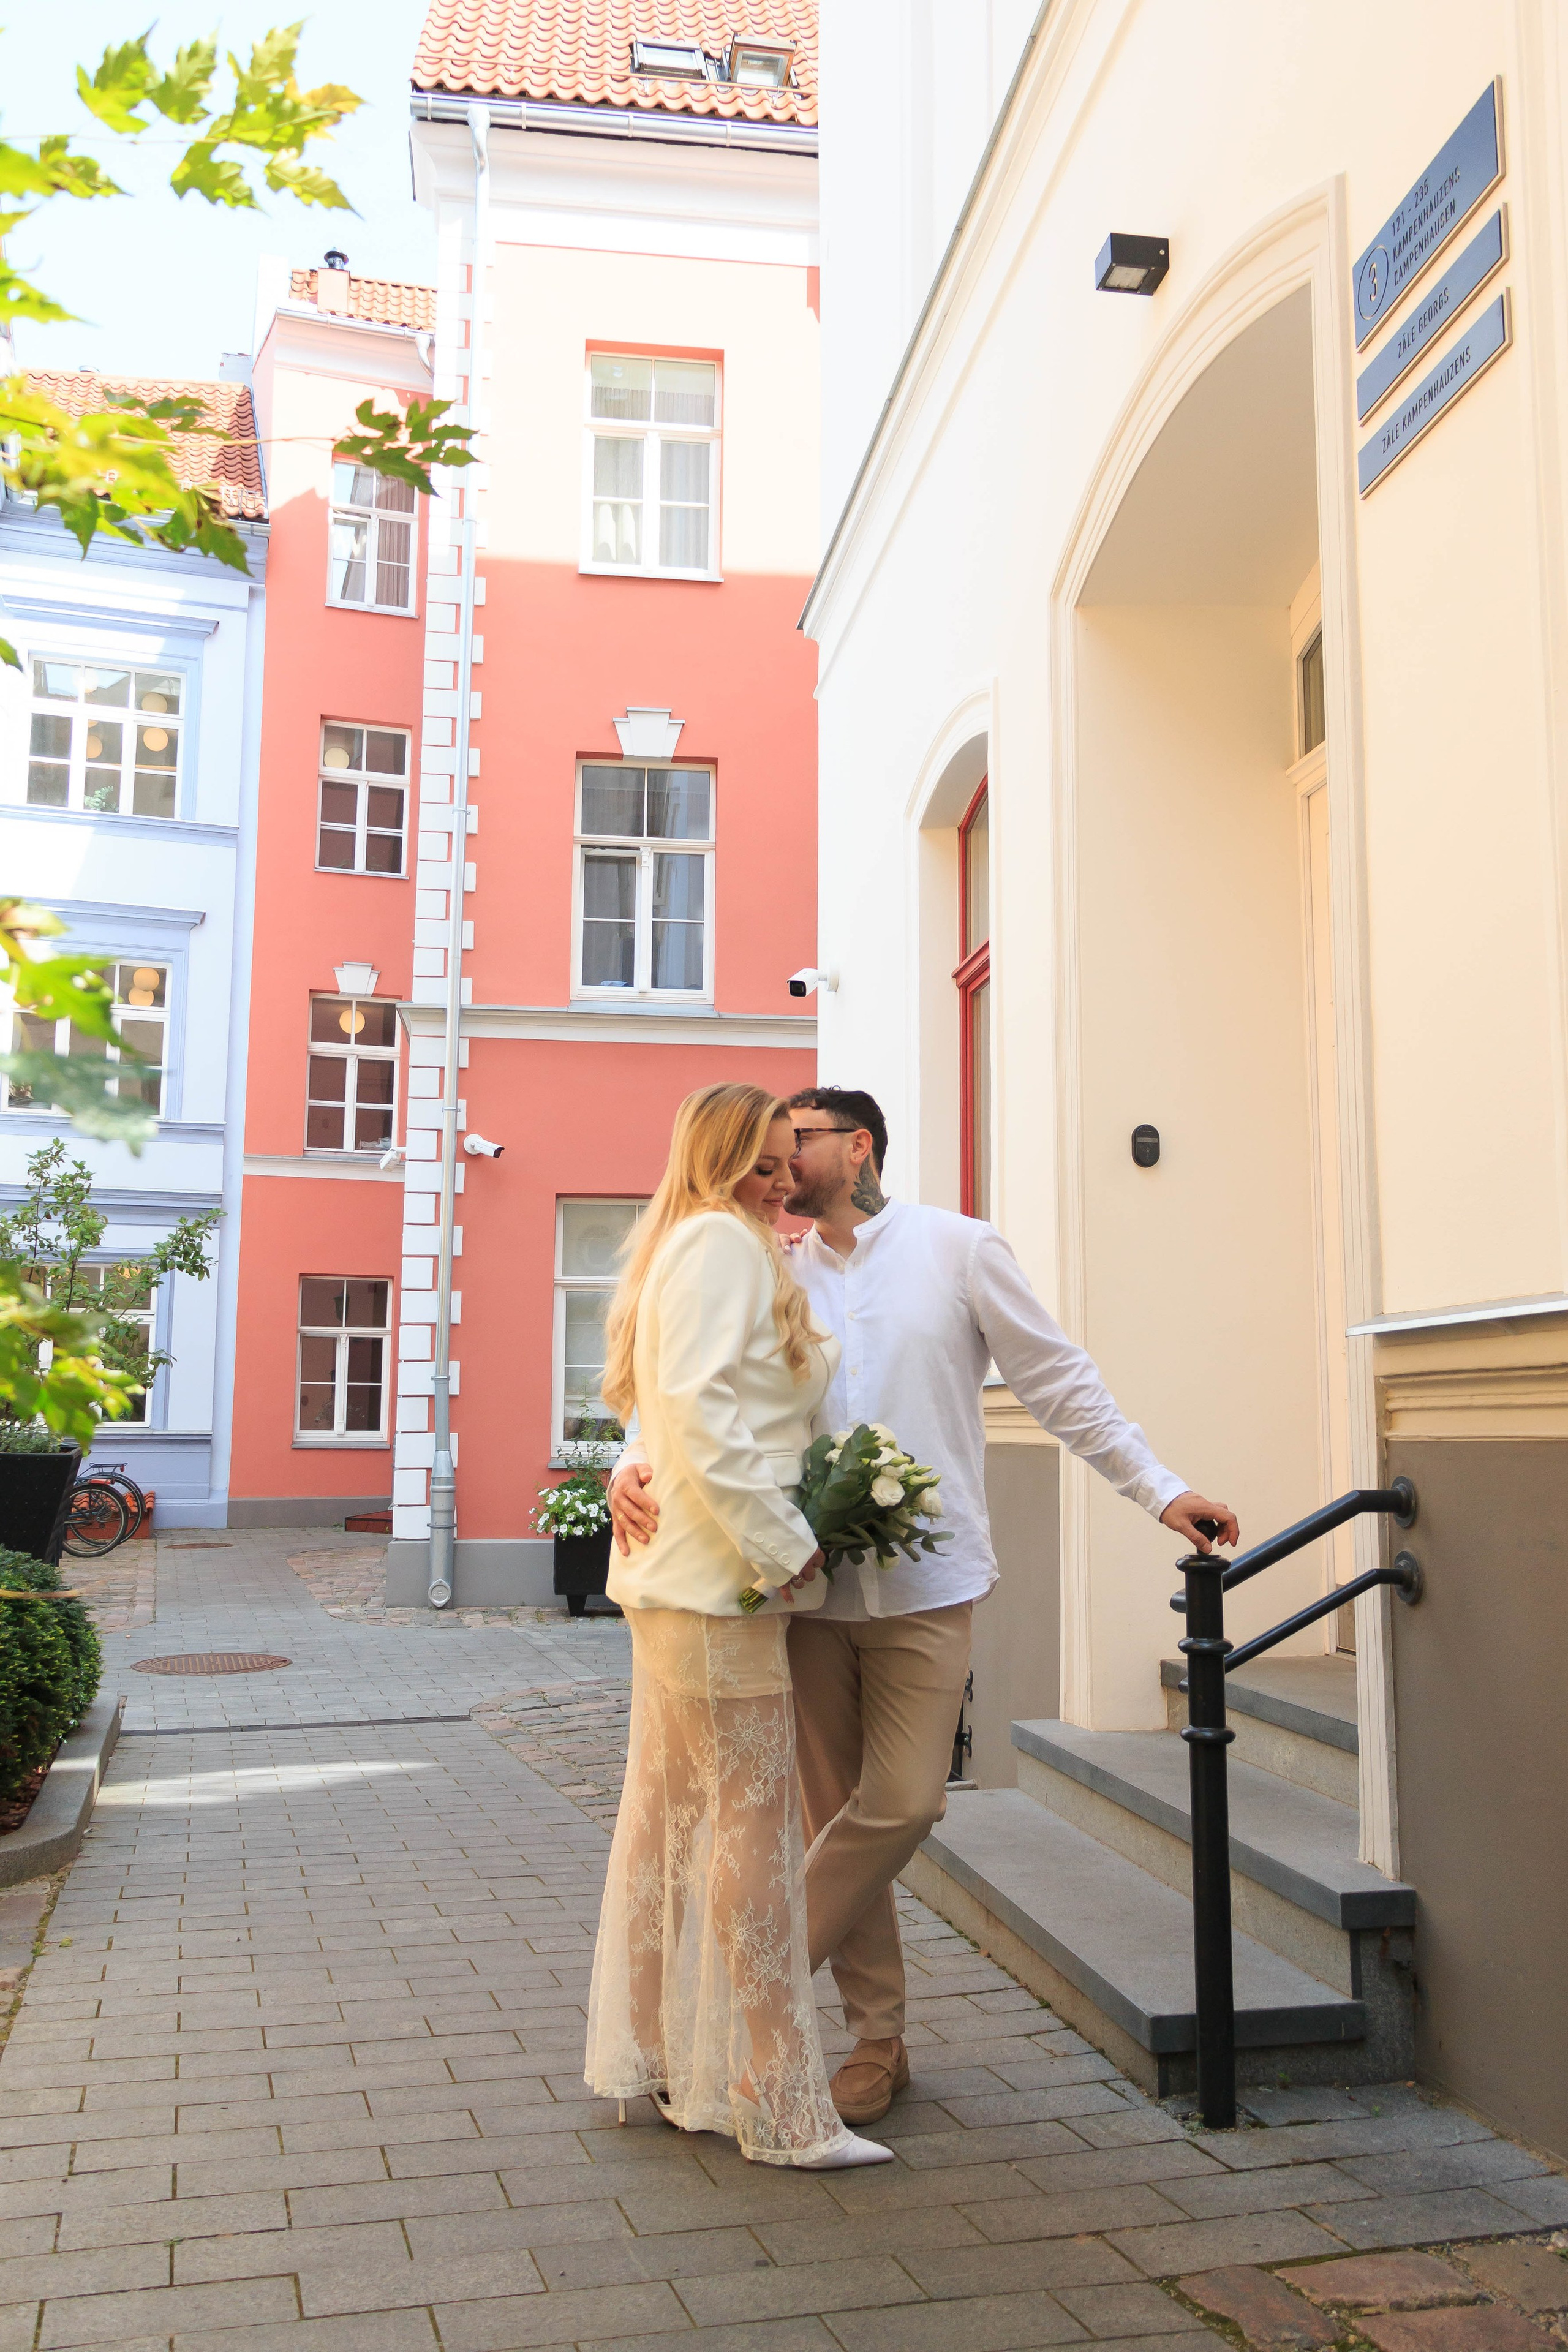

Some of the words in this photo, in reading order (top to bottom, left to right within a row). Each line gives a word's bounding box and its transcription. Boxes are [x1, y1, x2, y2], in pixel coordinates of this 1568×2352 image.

[1392, 210, 1404, 236] 121
[1414, 178, 1429, 209] 235
[1392, 165, 1460, 263] KAMPENHAUZENS
[1393, 198, 1456, 287] CAMPENHAUSEN
[1368, 262, 1378, 303] 3
[1398, 325, 1415, 359] ZĀLE
[1418, 287, 1449, 334] GEORGS
[1382, 423, 1400, 454] ZĀLE
[1402, 345, 1471, 432] KAMPENHAUZENS
